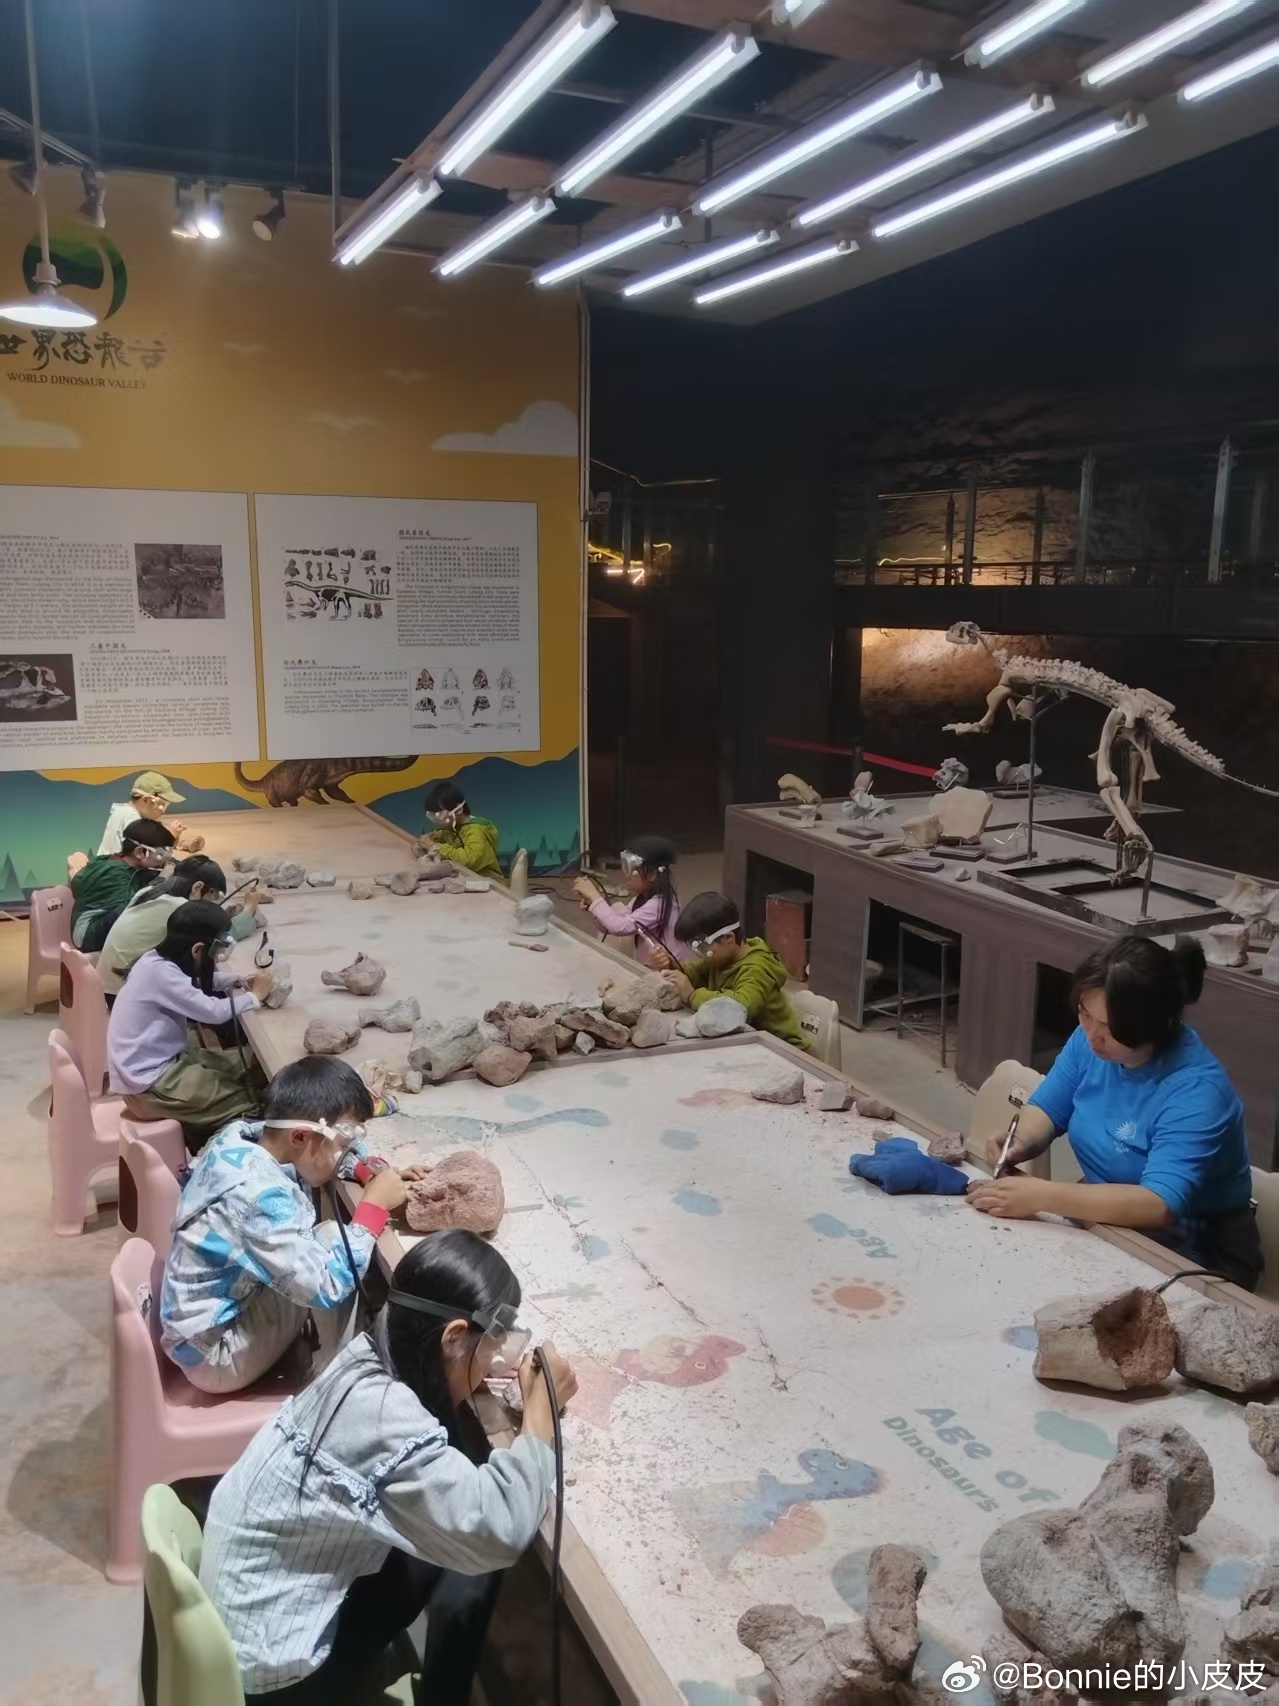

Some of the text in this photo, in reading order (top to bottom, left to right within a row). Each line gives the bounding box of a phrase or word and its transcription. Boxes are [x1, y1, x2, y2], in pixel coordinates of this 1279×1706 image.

[7, 372, 147, 390] WORLD DINOSAUR VALLEY
[914, 1408, 993, 1460] Age
[881, 1416, 1000, 1512] Dinosaurs
